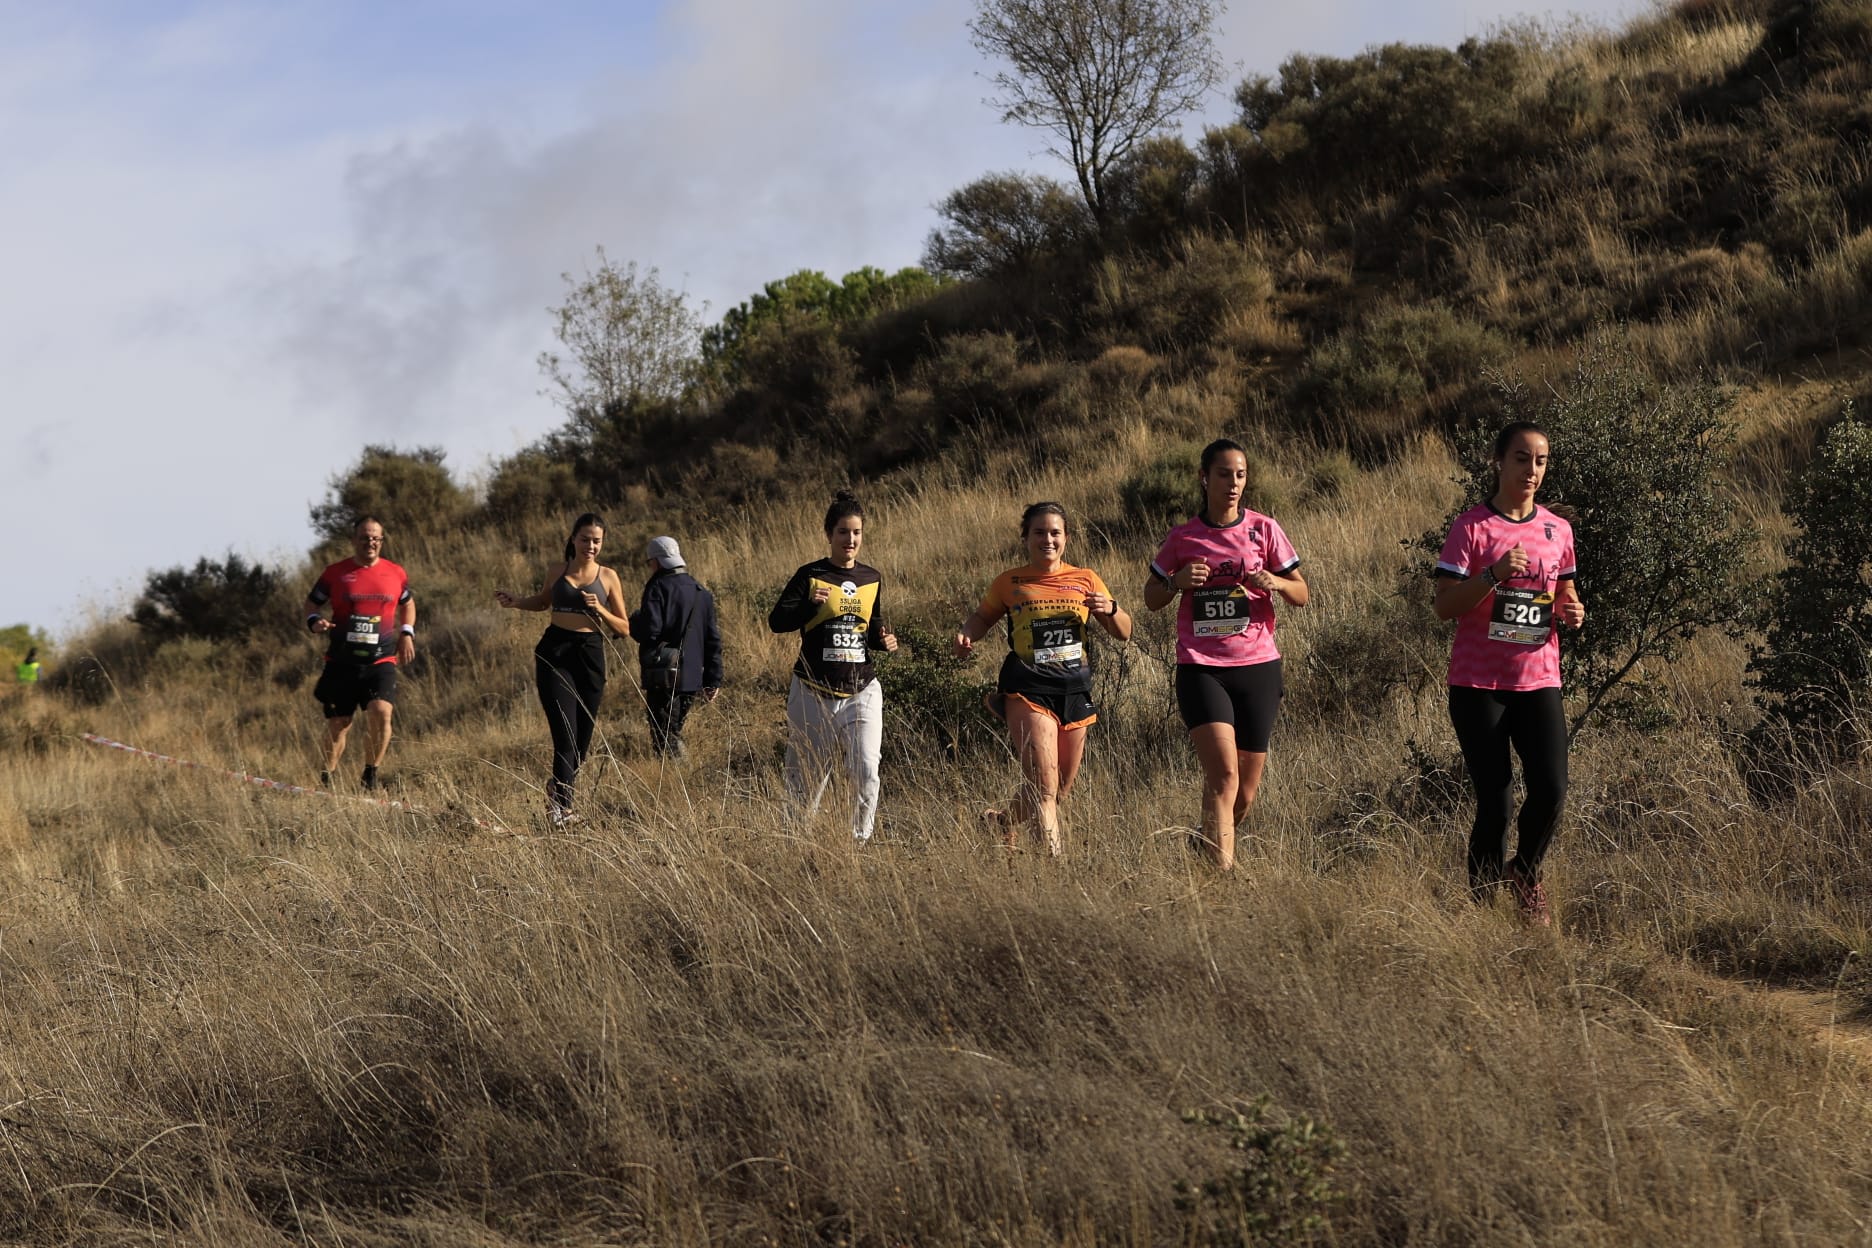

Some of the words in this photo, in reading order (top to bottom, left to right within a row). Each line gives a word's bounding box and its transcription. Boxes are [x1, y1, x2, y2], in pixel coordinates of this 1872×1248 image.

[840, 605, 861, 613] CROSS
[1204, 600, 1236, 618] 518
[1504, 603, 1541, 624] 520
[354, 622, 373, 632] 301
[832, 634, 859, 648] 632
[1043, 629, 1074, 646] 275
